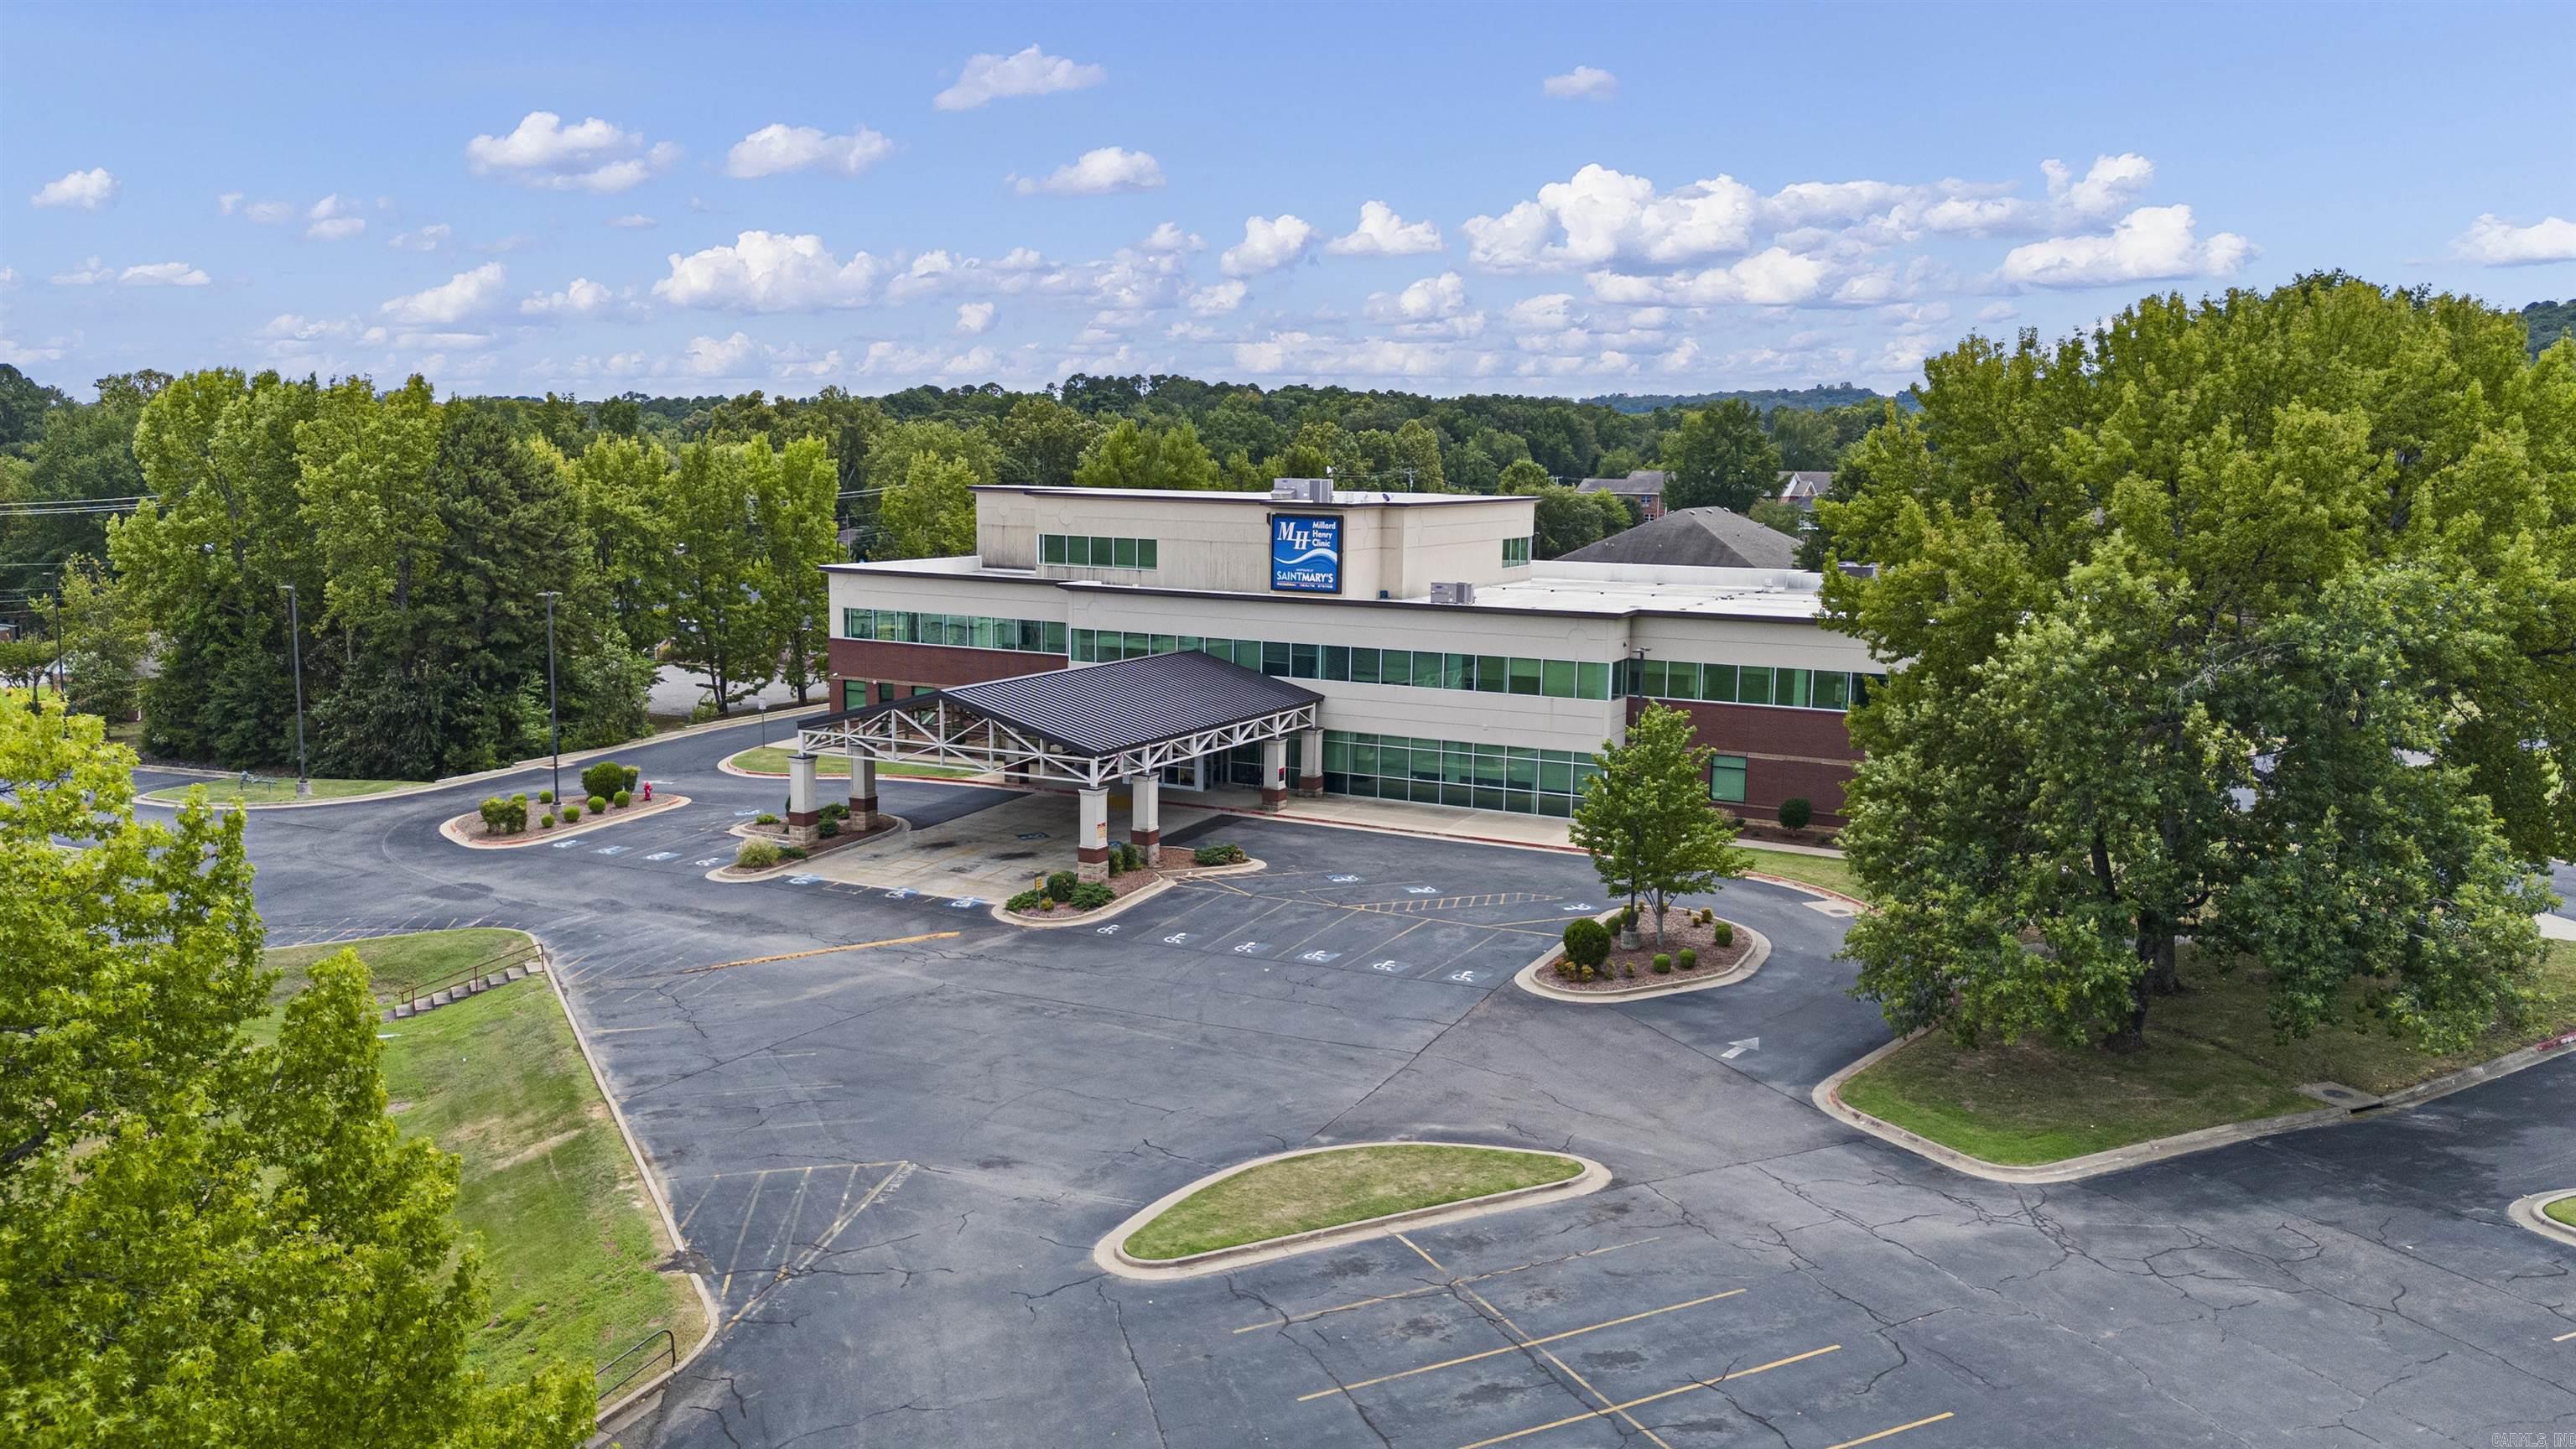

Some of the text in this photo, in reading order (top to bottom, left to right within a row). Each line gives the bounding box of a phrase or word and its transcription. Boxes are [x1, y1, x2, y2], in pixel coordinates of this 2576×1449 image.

[1312, 521, 1336, 529] Millard
[1312, 530, 1332, 539] Henry
[1312, 538, 1331, 547] Clinic
